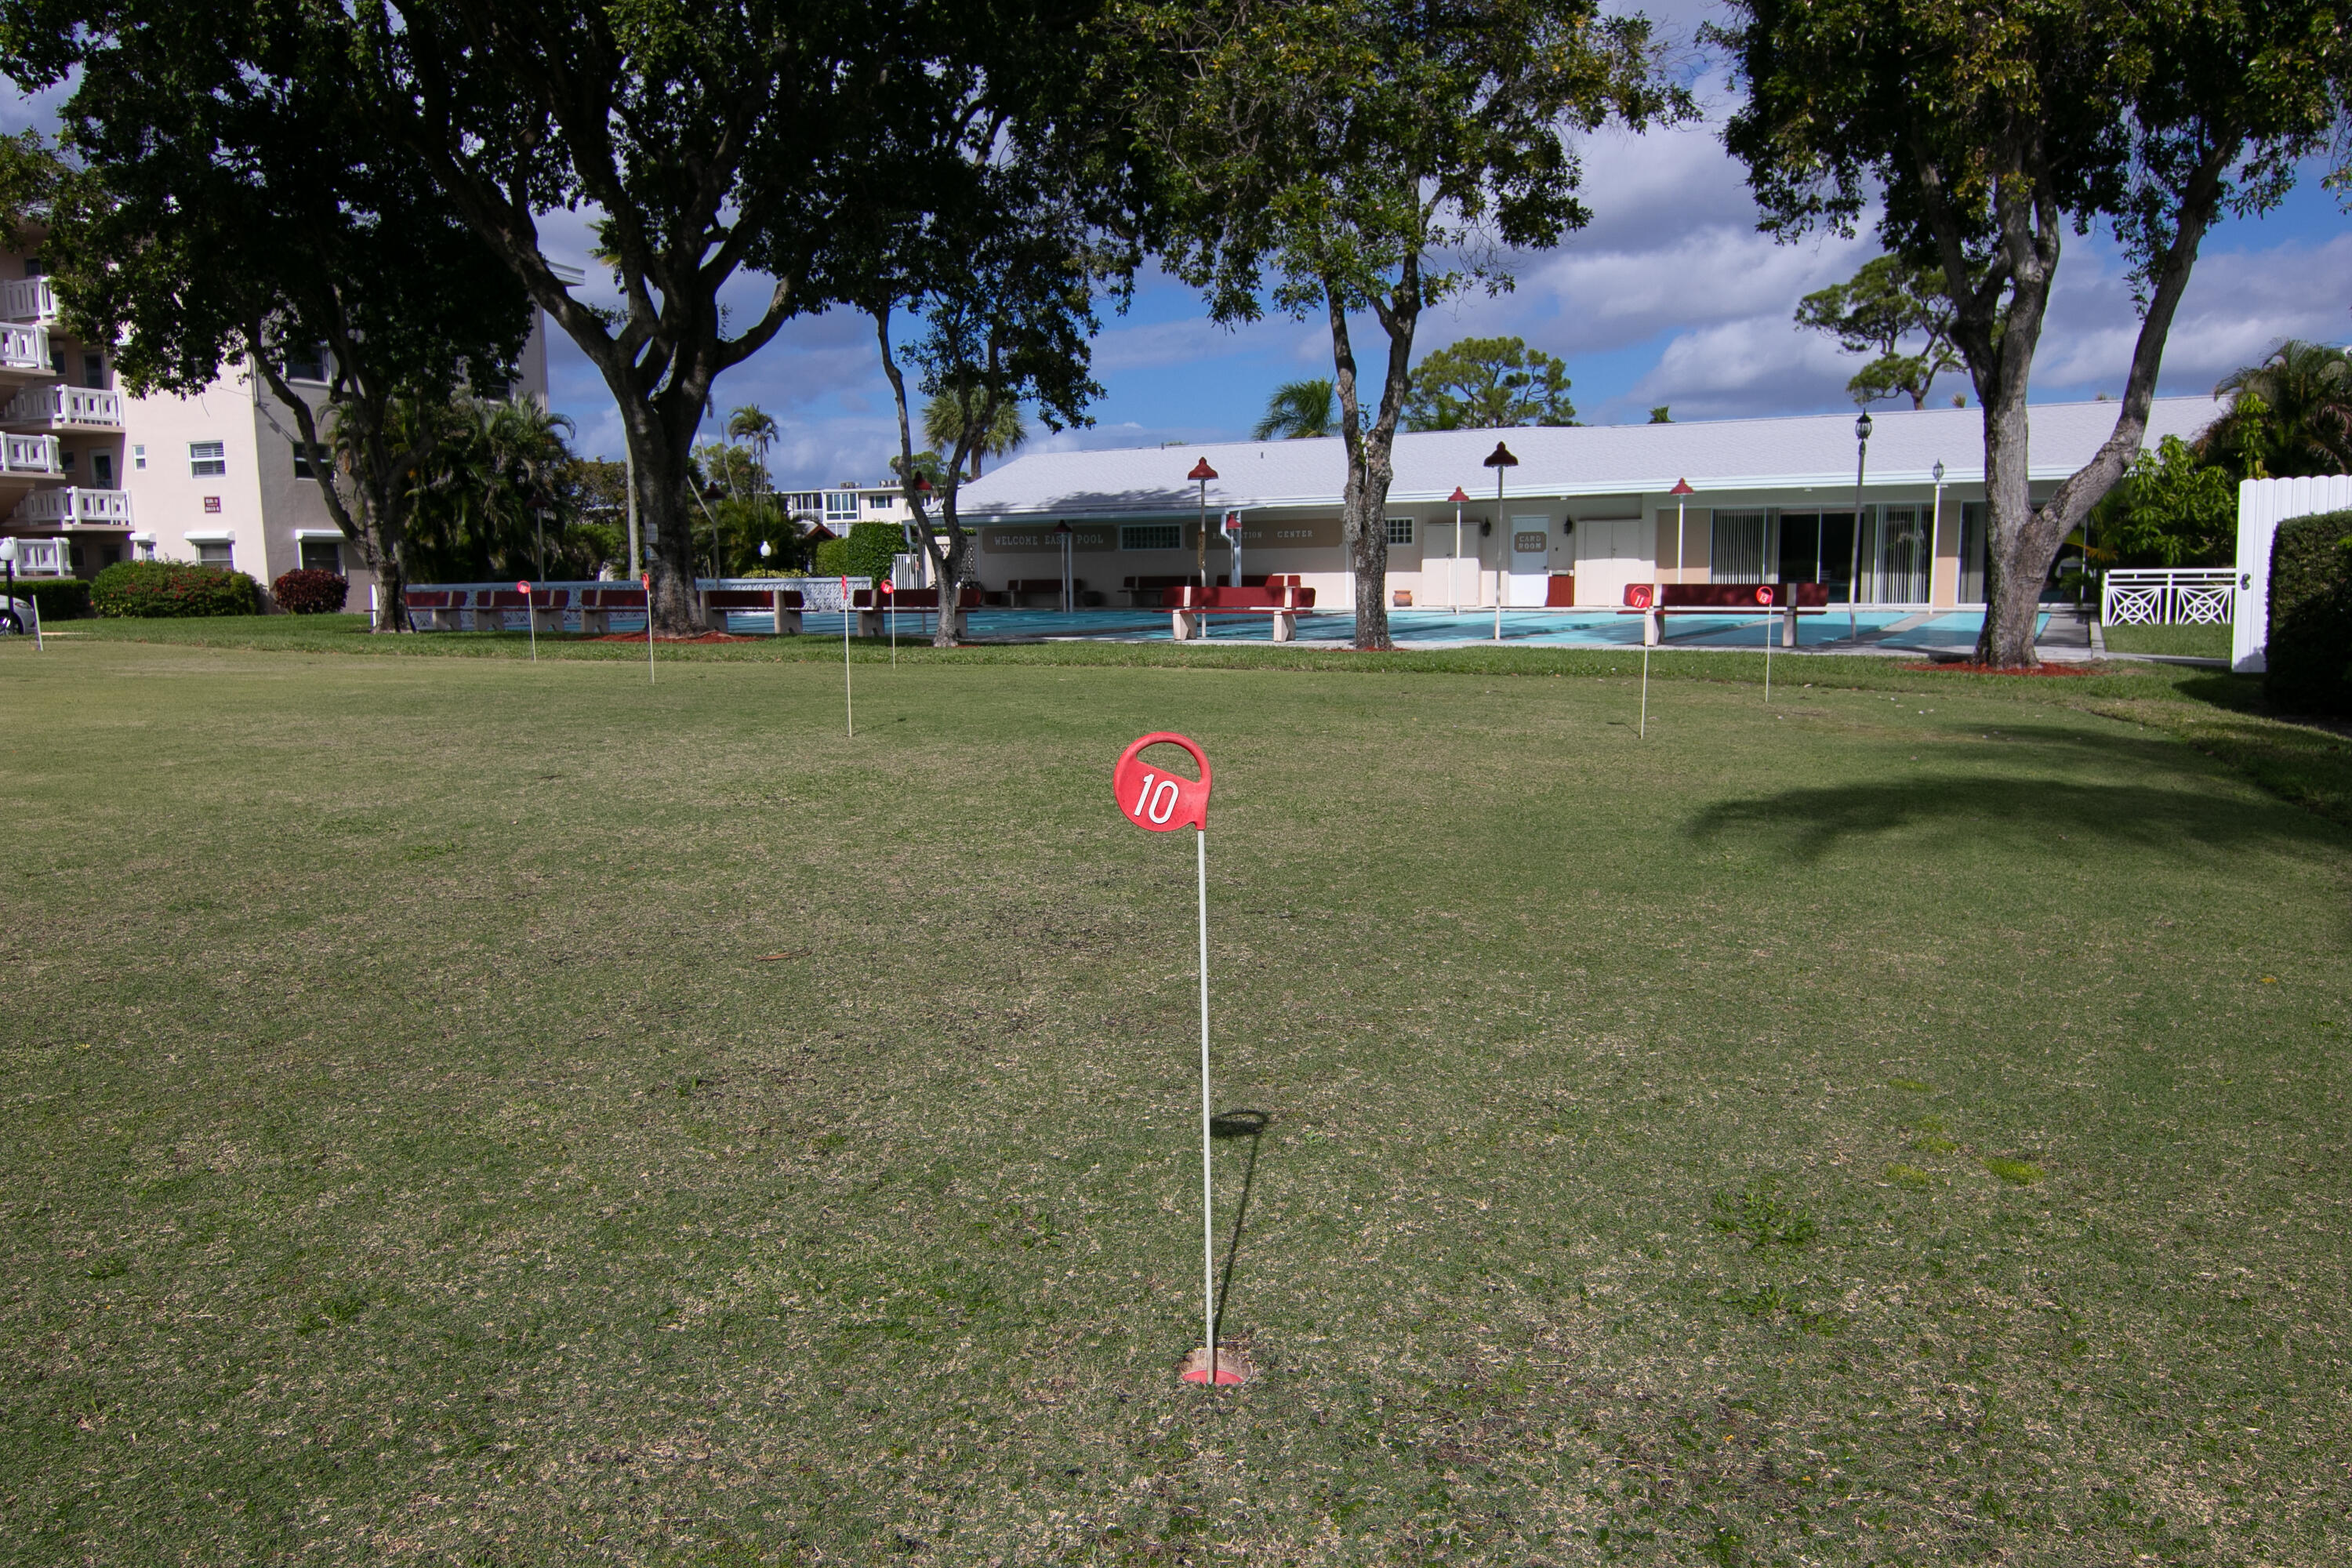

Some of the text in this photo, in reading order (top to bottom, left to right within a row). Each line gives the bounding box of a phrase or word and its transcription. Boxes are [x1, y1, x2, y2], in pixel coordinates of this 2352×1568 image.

[994, 534, 1103, 545] WELCOME EAST POOL
[1635, 595, 1645, 607] 11
[1759, 592, 1769, 603] 13
[1134, 773, 1179, 825] 10
